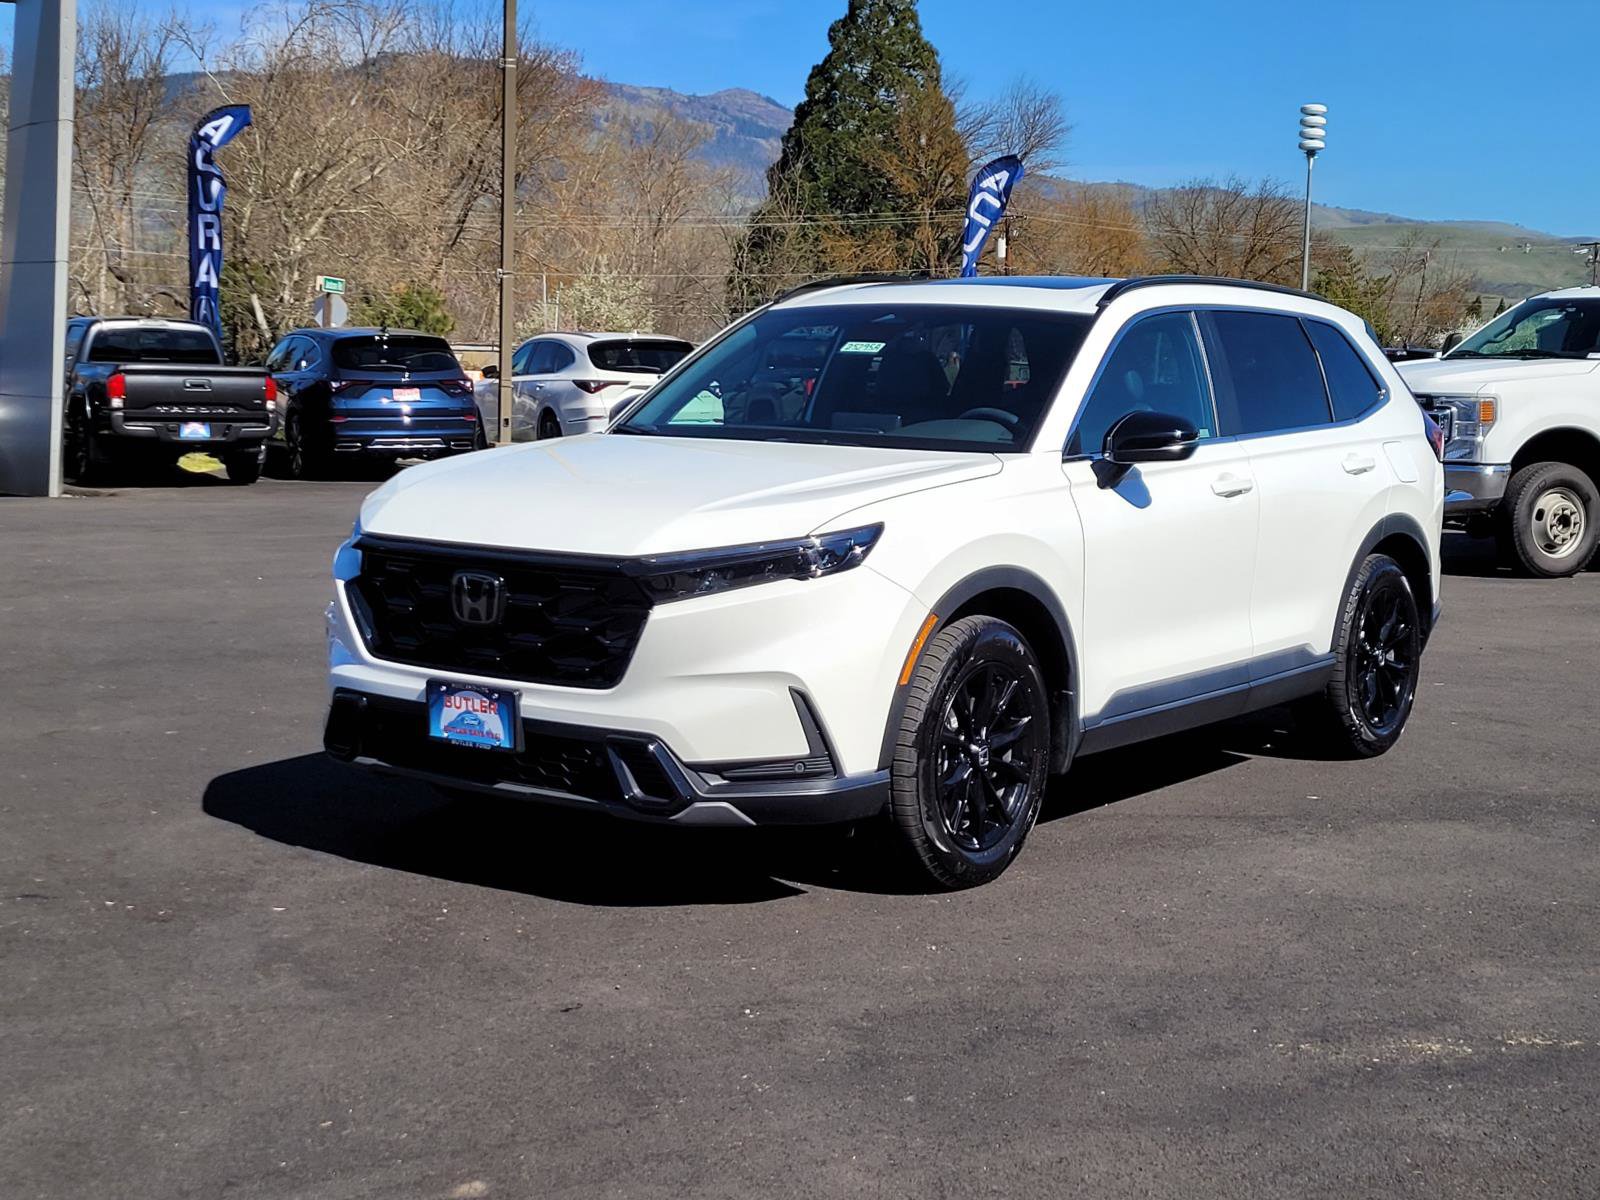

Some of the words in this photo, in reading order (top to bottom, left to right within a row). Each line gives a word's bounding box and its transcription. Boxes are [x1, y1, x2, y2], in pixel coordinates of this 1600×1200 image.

[195, 115, 233, 288] ACURA
[961, 169, 1010, 270] ACU
[444, 694, 499, 715] BUTLER
